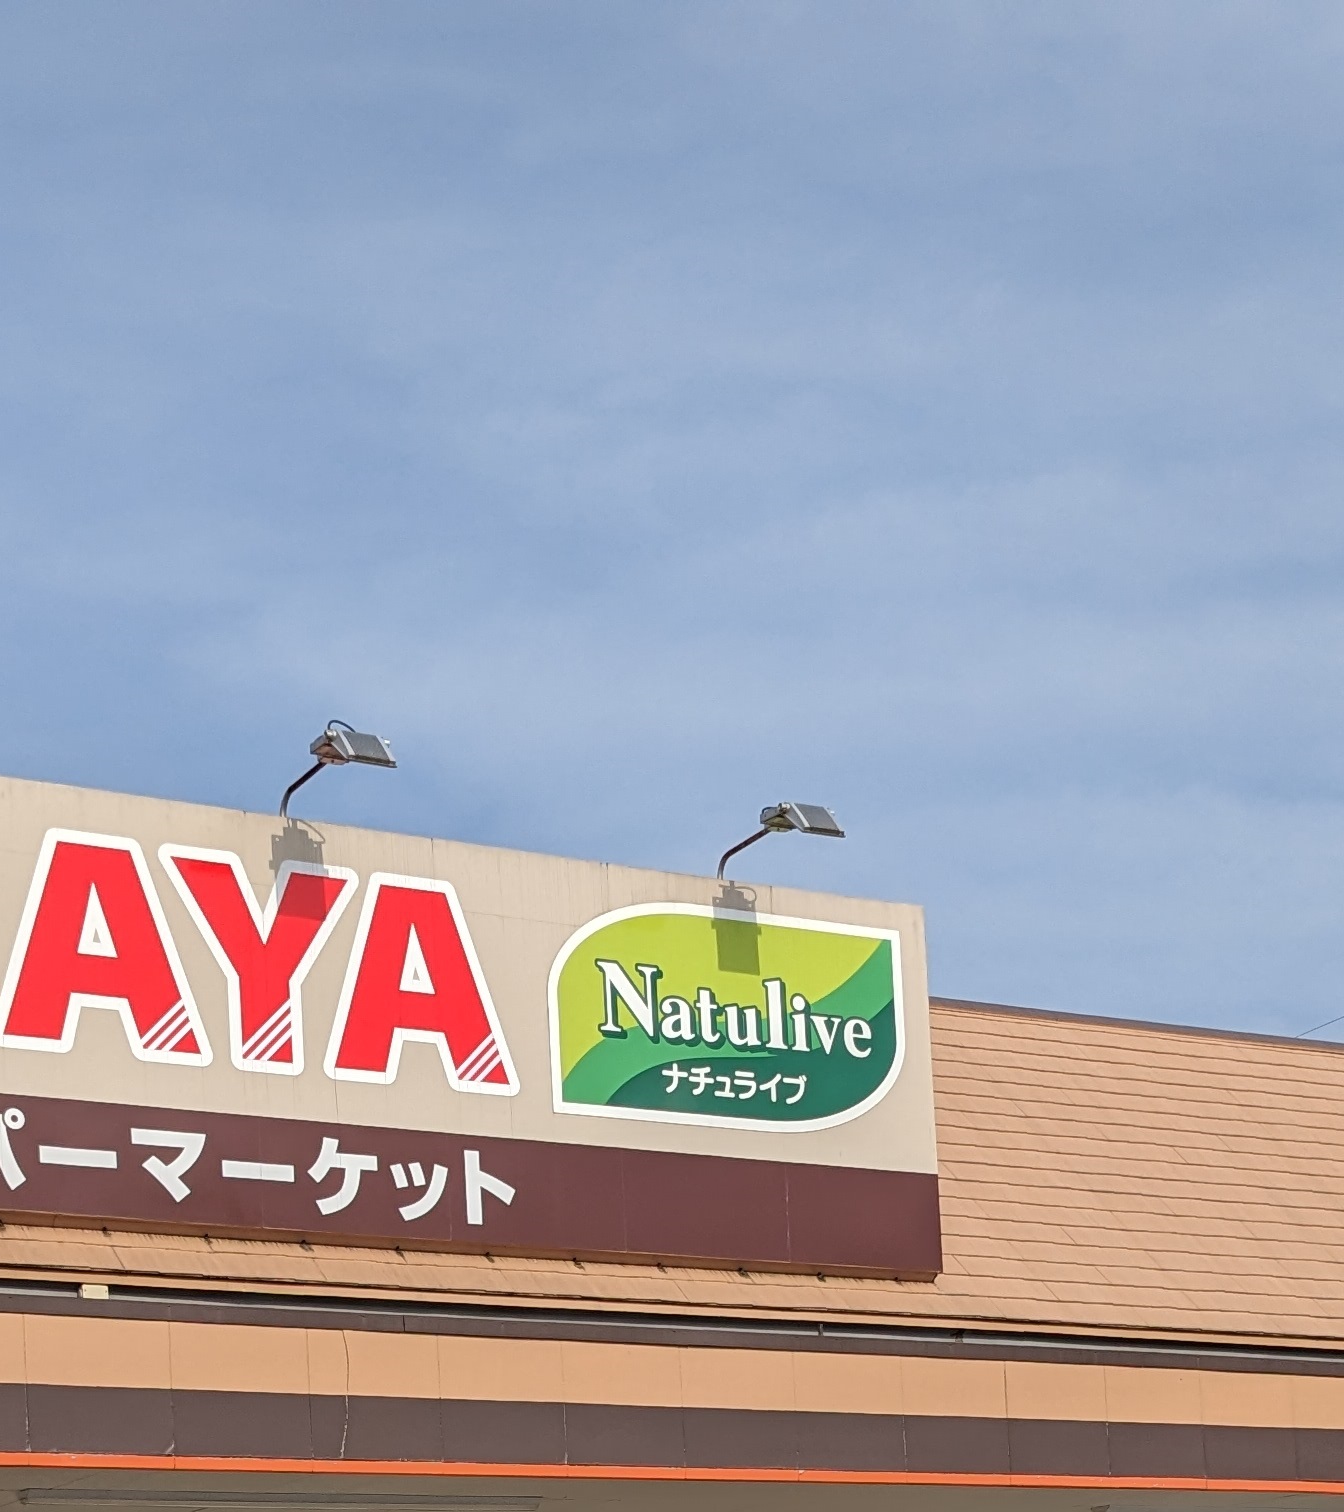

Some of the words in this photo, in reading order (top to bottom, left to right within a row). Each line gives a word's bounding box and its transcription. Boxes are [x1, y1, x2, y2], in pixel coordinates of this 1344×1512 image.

[595, 958, 873, 1059] Natulive
[661, 1063, 807, 1105] ナチュライブ
